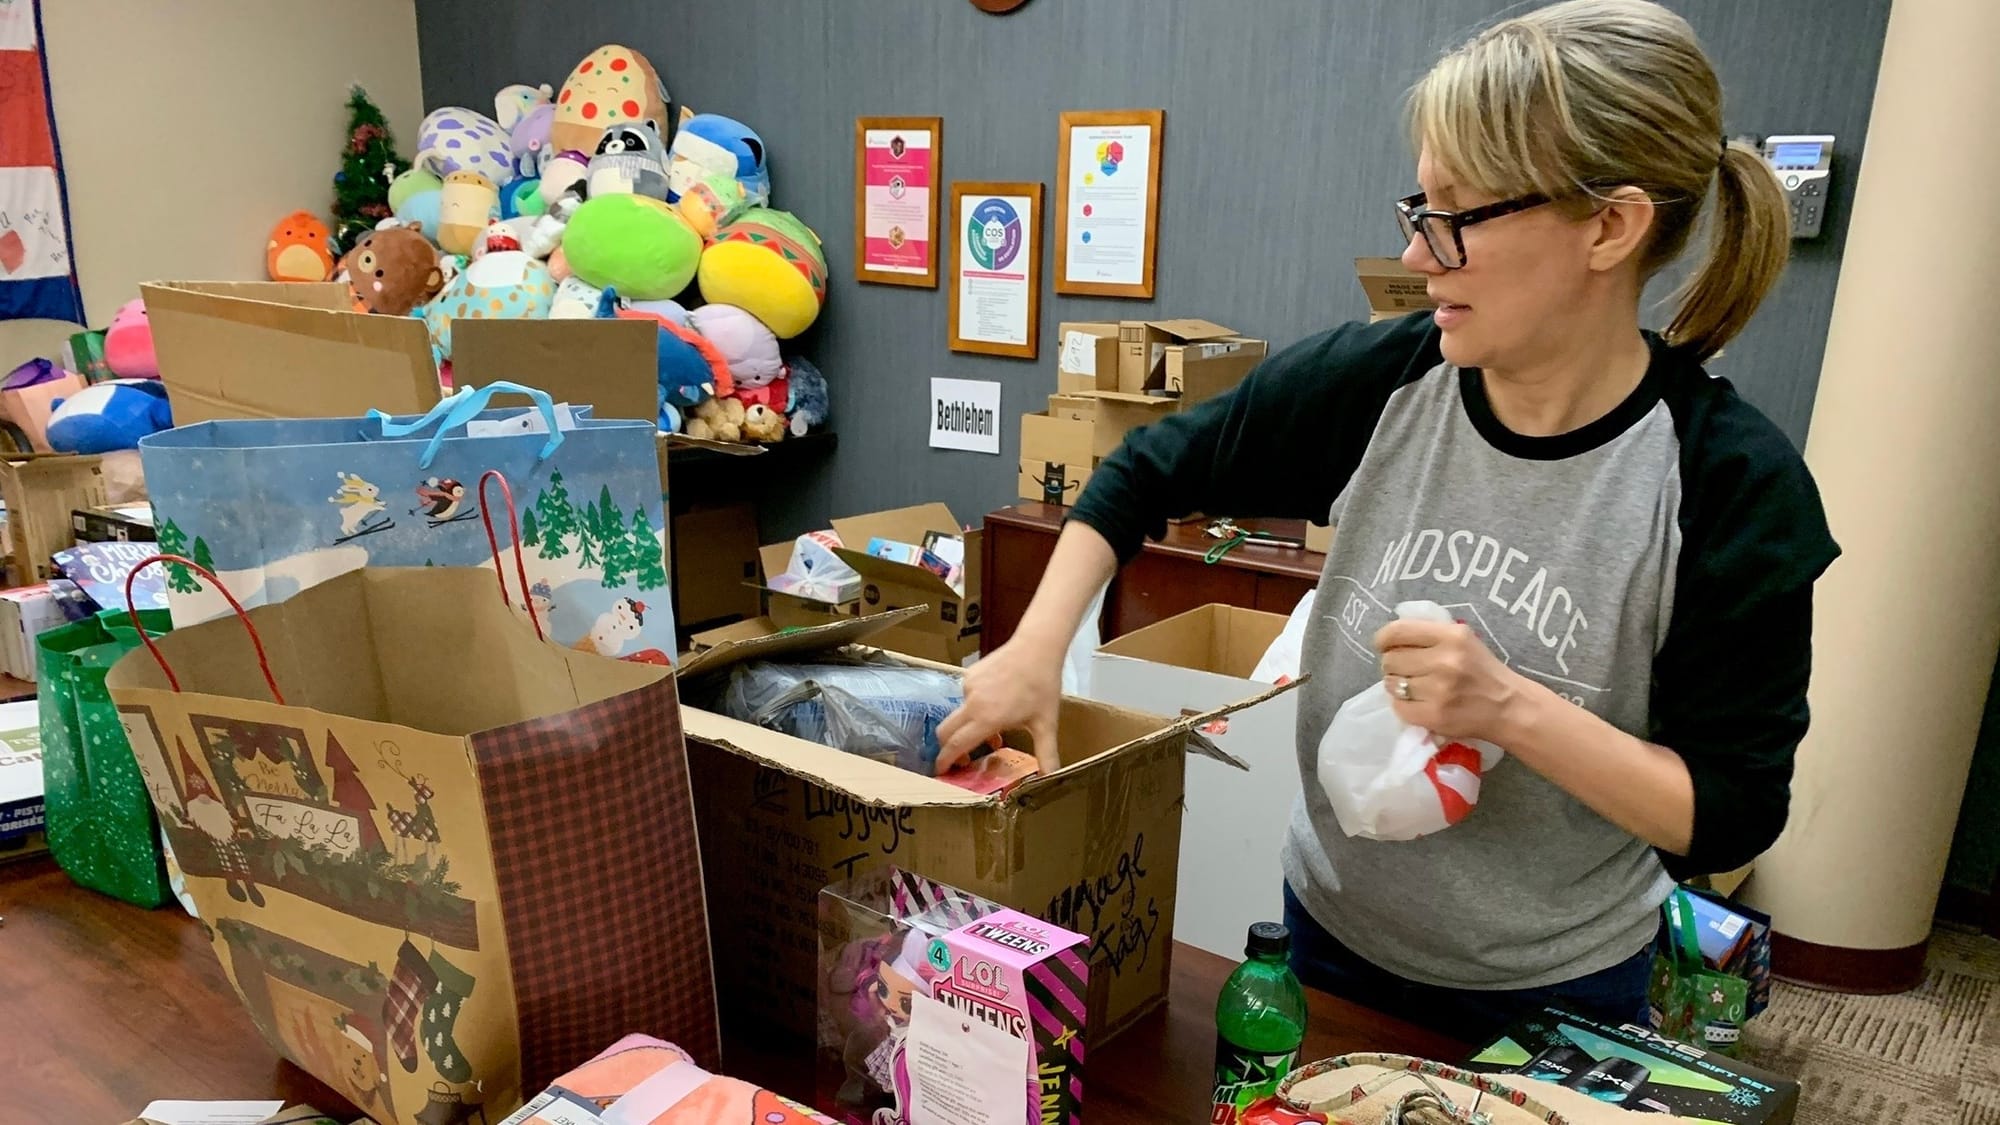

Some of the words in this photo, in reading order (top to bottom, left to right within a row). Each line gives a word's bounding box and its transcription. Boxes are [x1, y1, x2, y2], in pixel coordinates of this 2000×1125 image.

[985, 228, 1004, 238] COS
[936, 399, 993, 436] Bethlehem
[1342, 592, 1370, 634] EST.
[1370, 528, 1588, 675] KIDSPEACE
[258, 761, 279, 776] Be
[255, 803, 286, 827] Fa
[293, 810, 320, 840] La
[324, 819, 355, 850] La
[933, 946, 944, 964] 4
[973, 924, 1046, 955] TWEENS
[959, 955, 1010, 994] LOL
[1619, 1023, 1708, 1059] AXE
[1539, 1059, 1574, 1075] AXE
[1587, 1070, 1636, 1092] AXE
[1695, 1060, 1739, 1079] GIFT
[1737, 1075, 1776, 1094] SET
